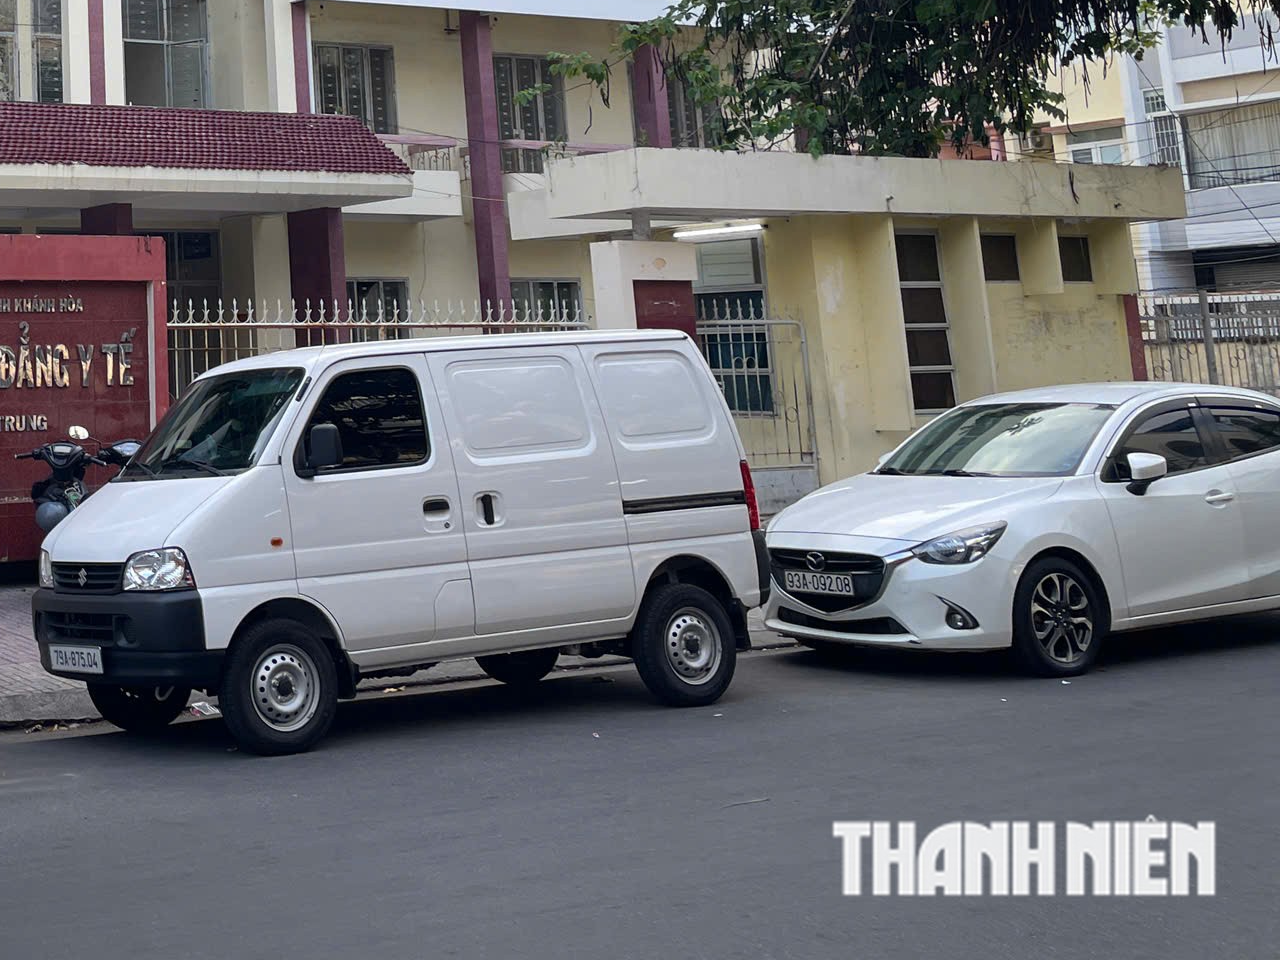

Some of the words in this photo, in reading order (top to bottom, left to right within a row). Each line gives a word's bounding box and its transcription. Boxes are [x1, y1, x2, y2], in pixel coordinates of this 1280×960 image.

[14, 294, 56, 313] KHÁNH
[59, 294, 84, 313] HÒA
[76, 343, 95, 387] Y
[101, 327, 137, 386] TẾ
[787, 571, 851, 594] 93A-092.08
[53, 648, 98, 670] 79A-875.04
